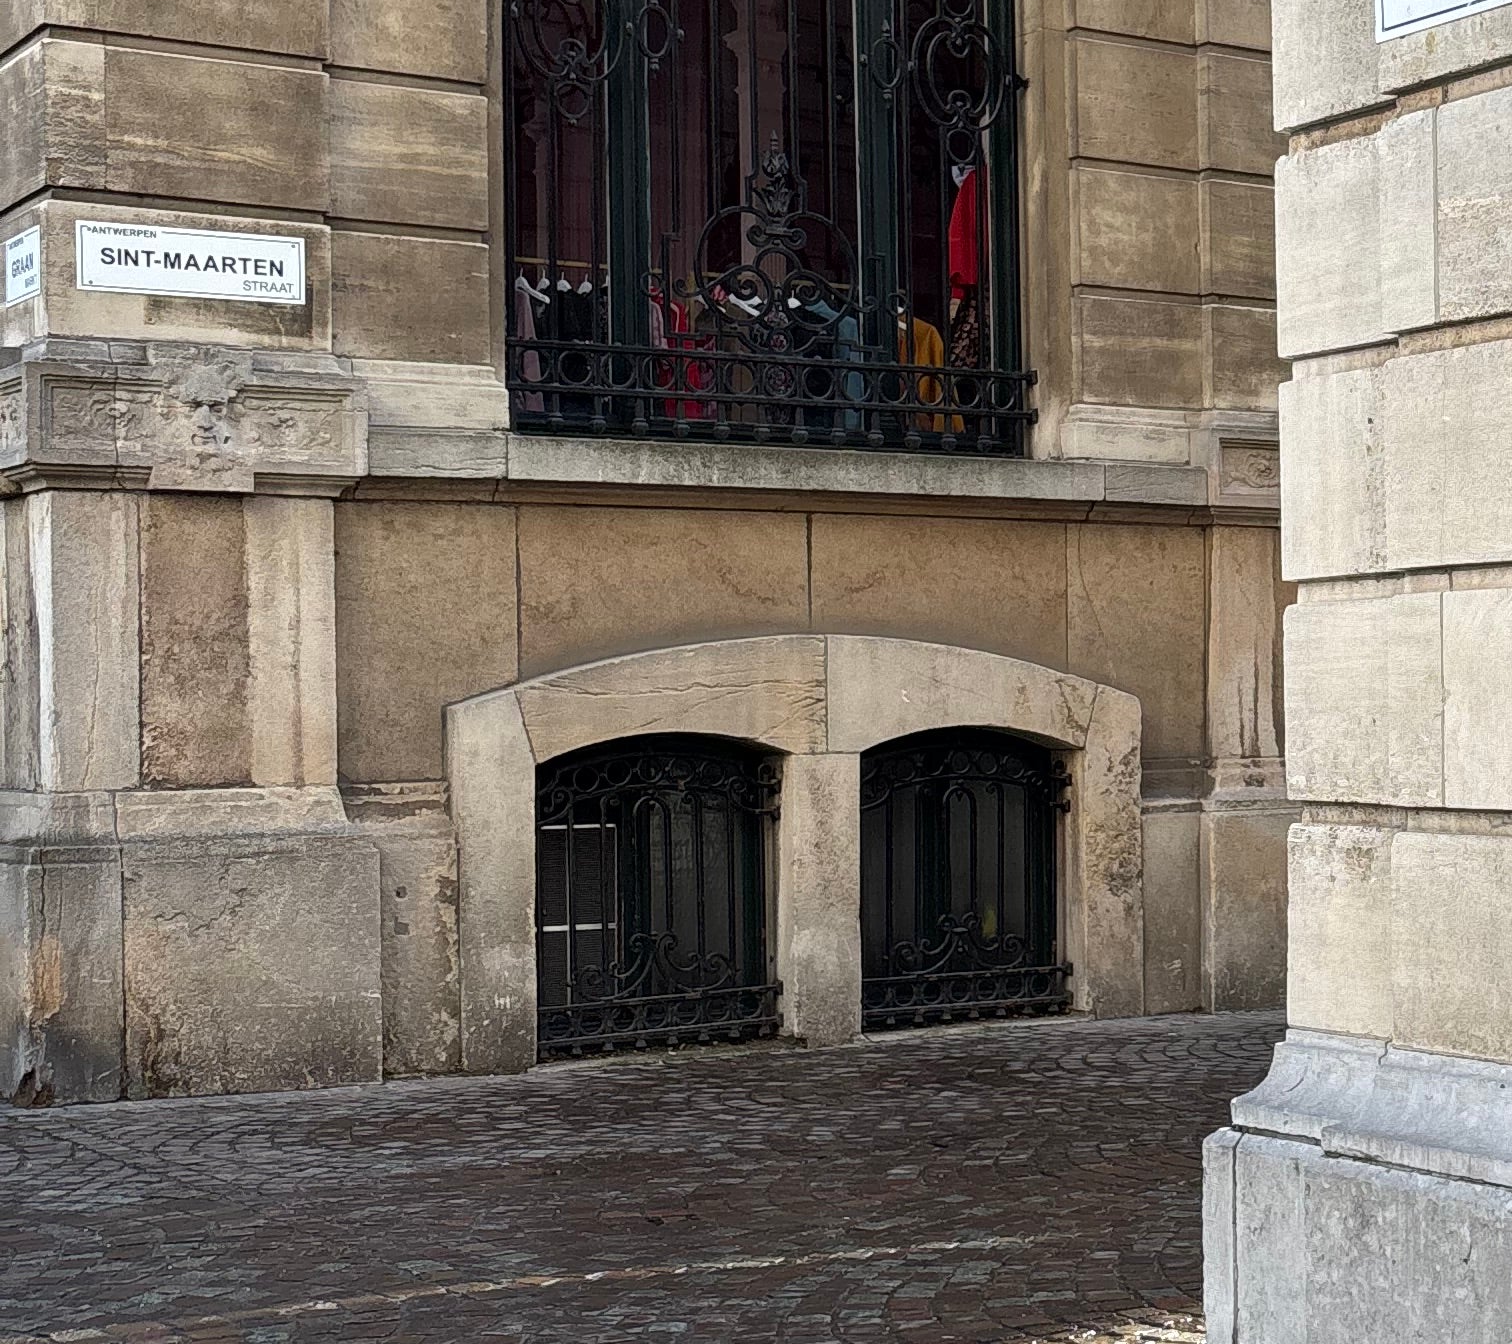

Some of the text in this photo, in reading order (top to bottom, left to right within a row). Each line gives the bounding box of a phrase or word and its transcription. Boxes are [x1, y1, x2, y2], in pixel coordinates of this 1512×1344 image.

[91, 225, 157, 239] ANTWERPEN
[100, 247, 284, 278] SINT-MAARTEN
[242, 279, 295, 293] STRAAT
